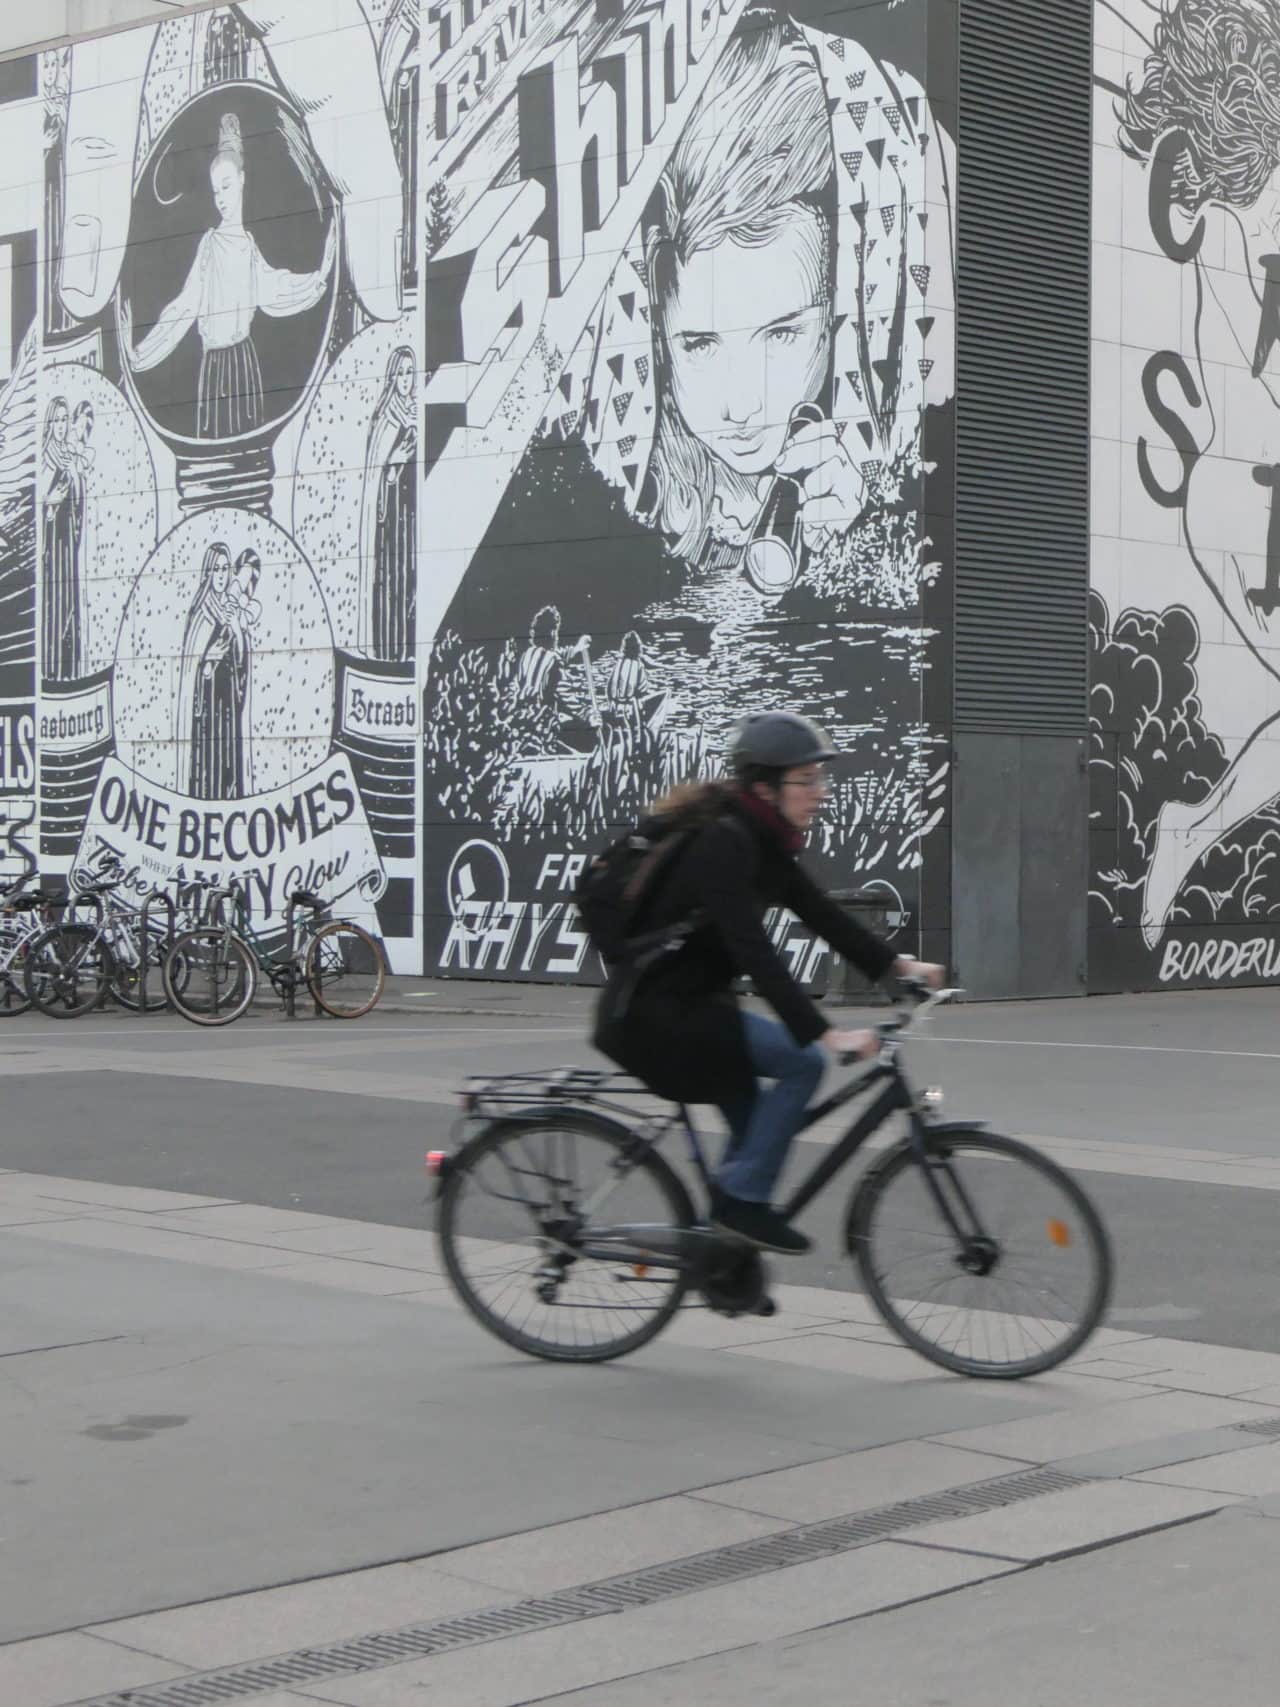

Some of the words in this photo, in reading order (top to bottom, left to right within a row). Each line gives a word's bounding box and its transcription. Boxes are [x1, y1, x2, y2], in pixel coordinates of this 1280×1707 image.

[0, 714, 35, 789] LS
[101, 776, 170, 852] ONE
[176, 769, 355, 862] BECOMES
[439, 901, 592, 973] RAYS
